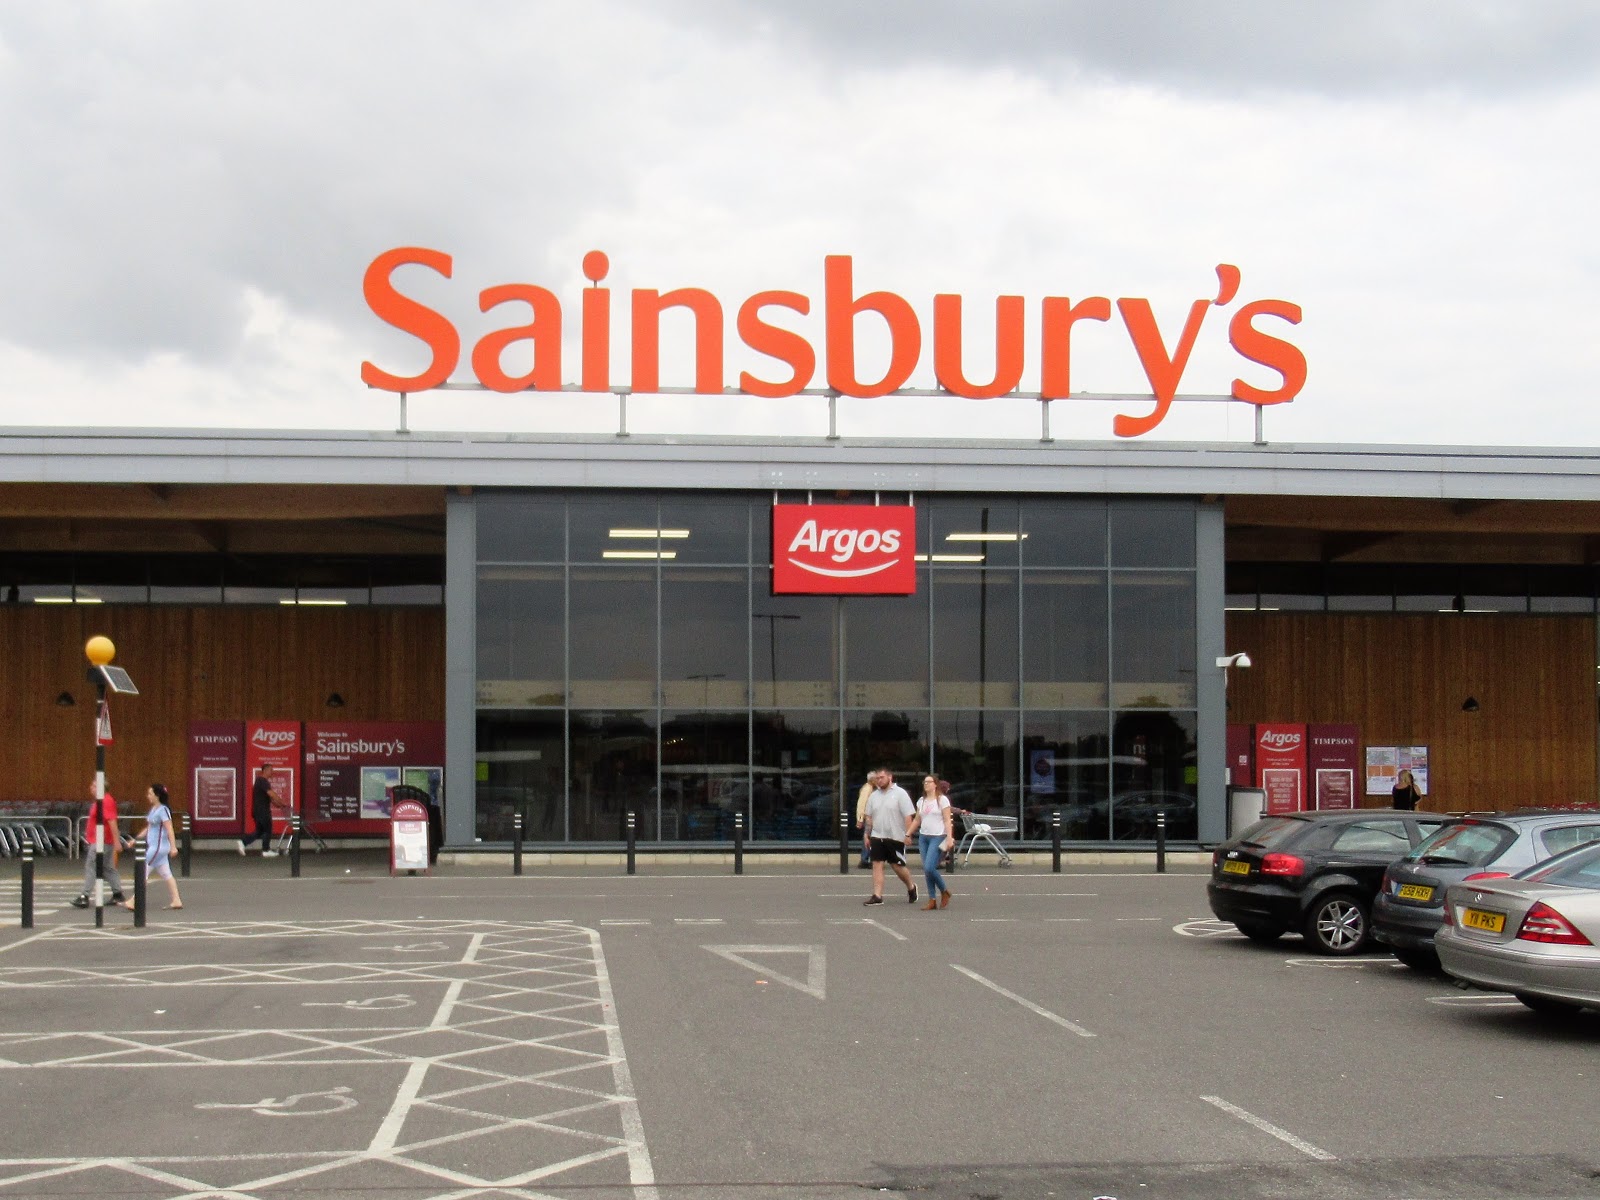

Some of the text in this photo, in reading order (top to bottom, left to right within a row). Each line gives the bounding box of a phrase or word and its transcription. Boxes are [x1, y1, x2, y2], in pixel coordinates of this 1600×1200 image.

[361, 247, 1307, 436] Sainsbury's
[787, 519, 901, 563] Argos
[194, 735, 239, 743] TIMPSON
[252, 728, 296, 745] Argos
[1260, 730, 1301, 747] Argos
[317, 738, 405, 756] Sainsbury's
[397, 804, 423, 814] TIMPSON
[1481, 913, 1496, 928] PKS
